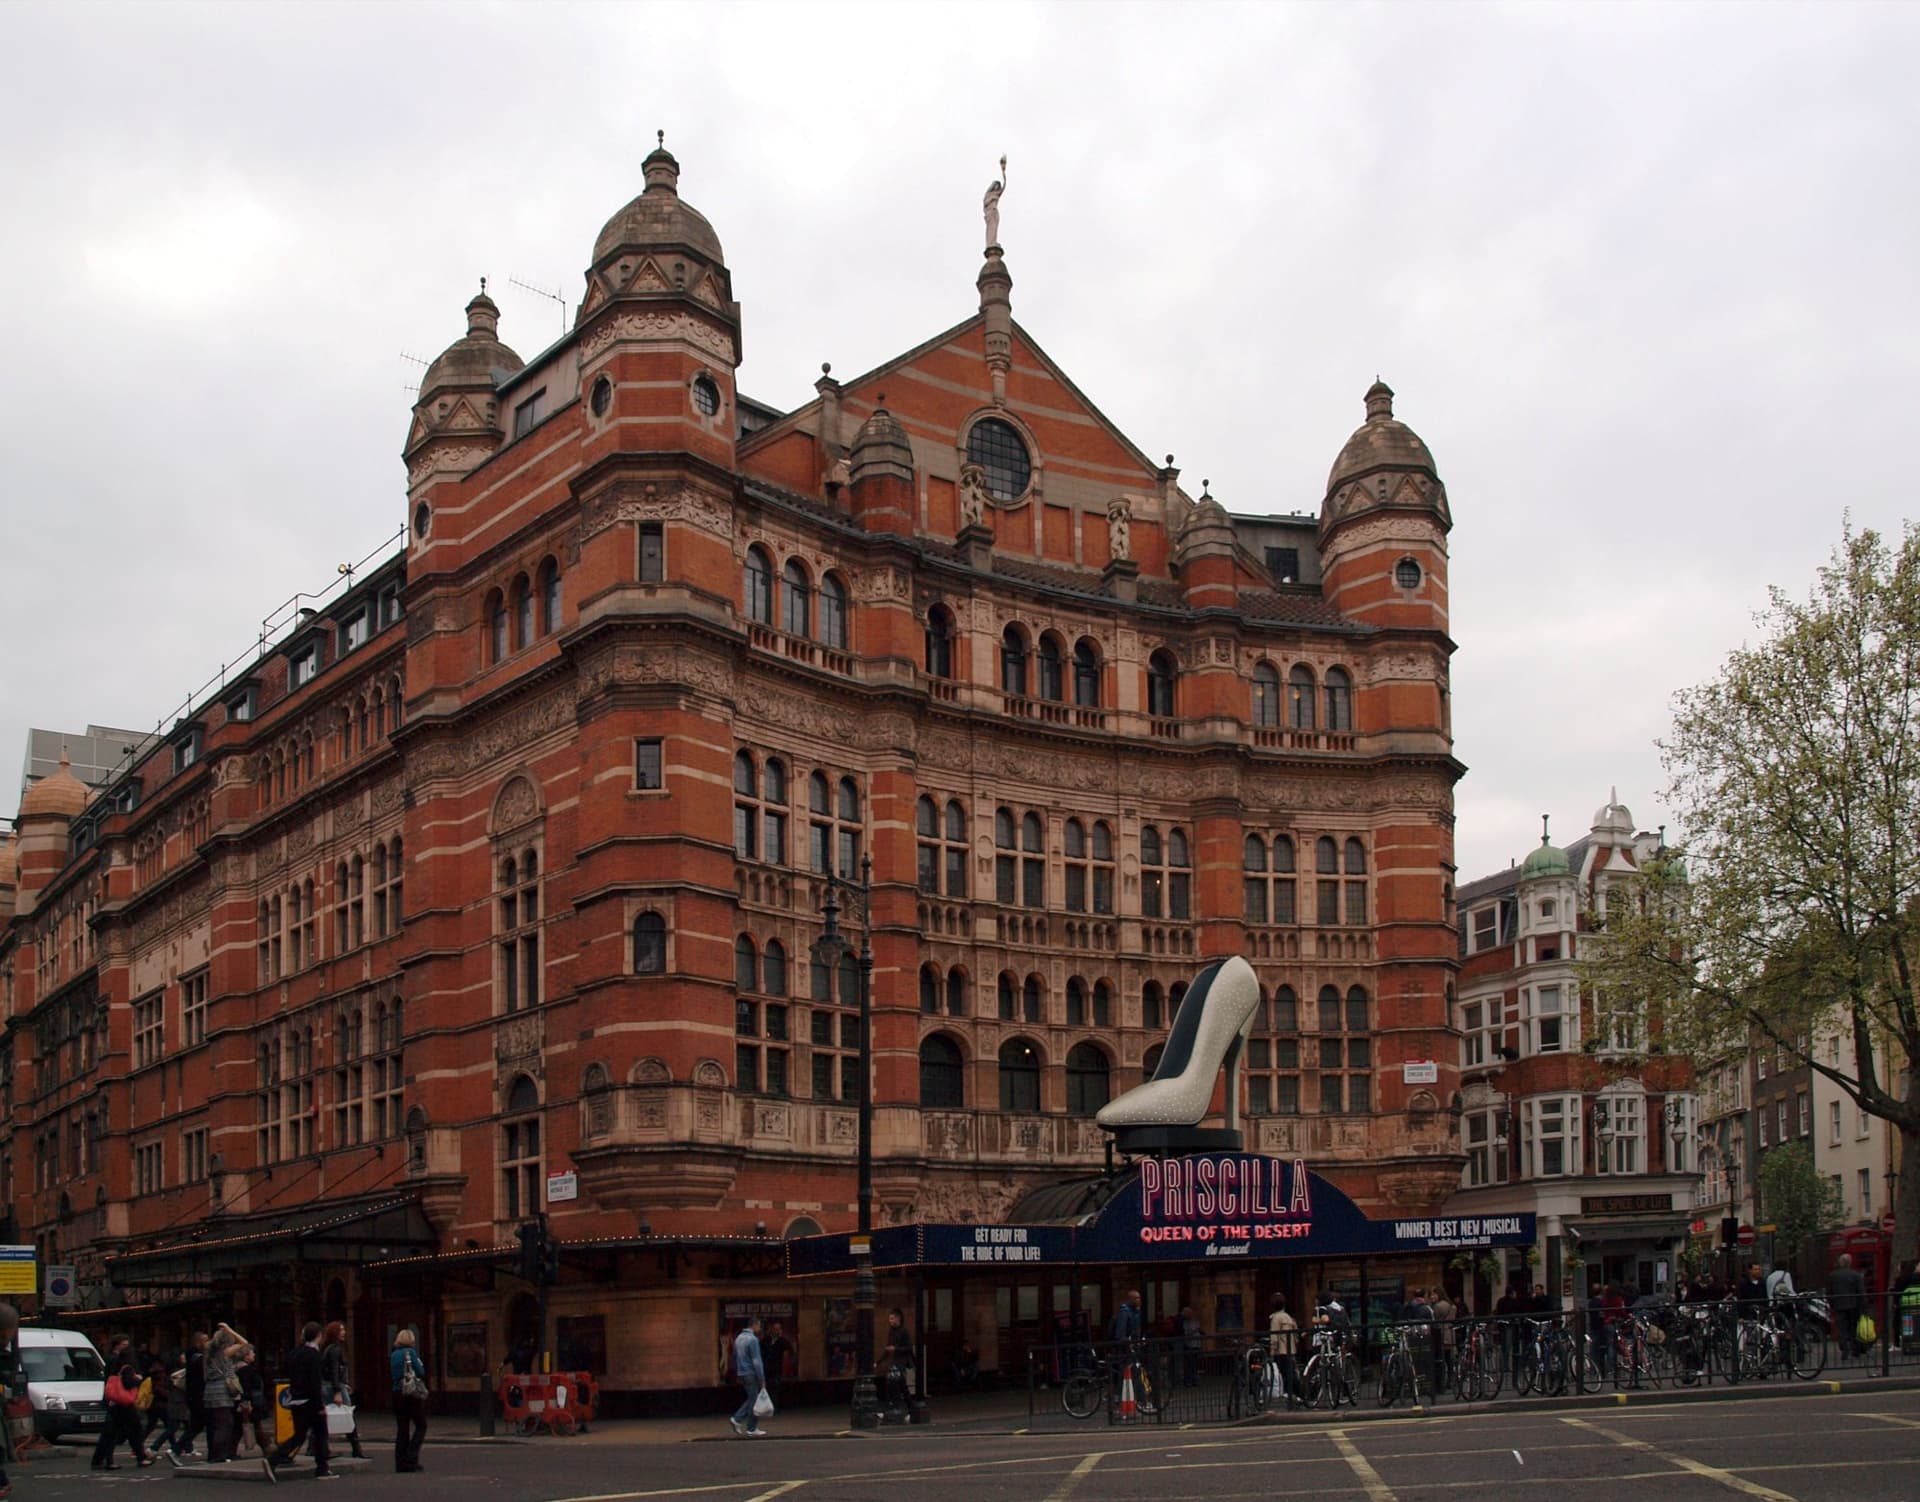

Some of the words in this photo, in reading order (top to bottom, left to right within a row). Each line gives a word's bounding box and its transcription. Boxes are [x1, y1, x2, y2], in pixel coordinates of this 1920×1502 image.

[1141, 1158, 1312, 1217] PRISCILLA
[975, 1228, 989, 1243] GET
[990, 1228, 1012, 1243] READY
[1013, 1228, 1028, 1243] FOR
[1140, 1226, 1192, 1242] QUEEN
[1196, 1225, 1218, 1240] OF
[1220, 1225, 1250, 1239] THE
[1254, 1223, 1312, 1239] DESERT
[1395, 1222, 1432, 1239] WINNER
[1434, 1221, 1457, 1237] BEST
[1460, 1219, 1480, 1236] NEW
[1482, 1217, 1521, 1234] MUSICAL
[961, 1246, 975, 1261] THE
[976, 1246, 993, 1261] RIDE
[994, 1246, 1004, 1260] OF
[1005, 1246, 1024, 1260] YOUR
[1024, 1246, 1041, 1260] LIFE!
